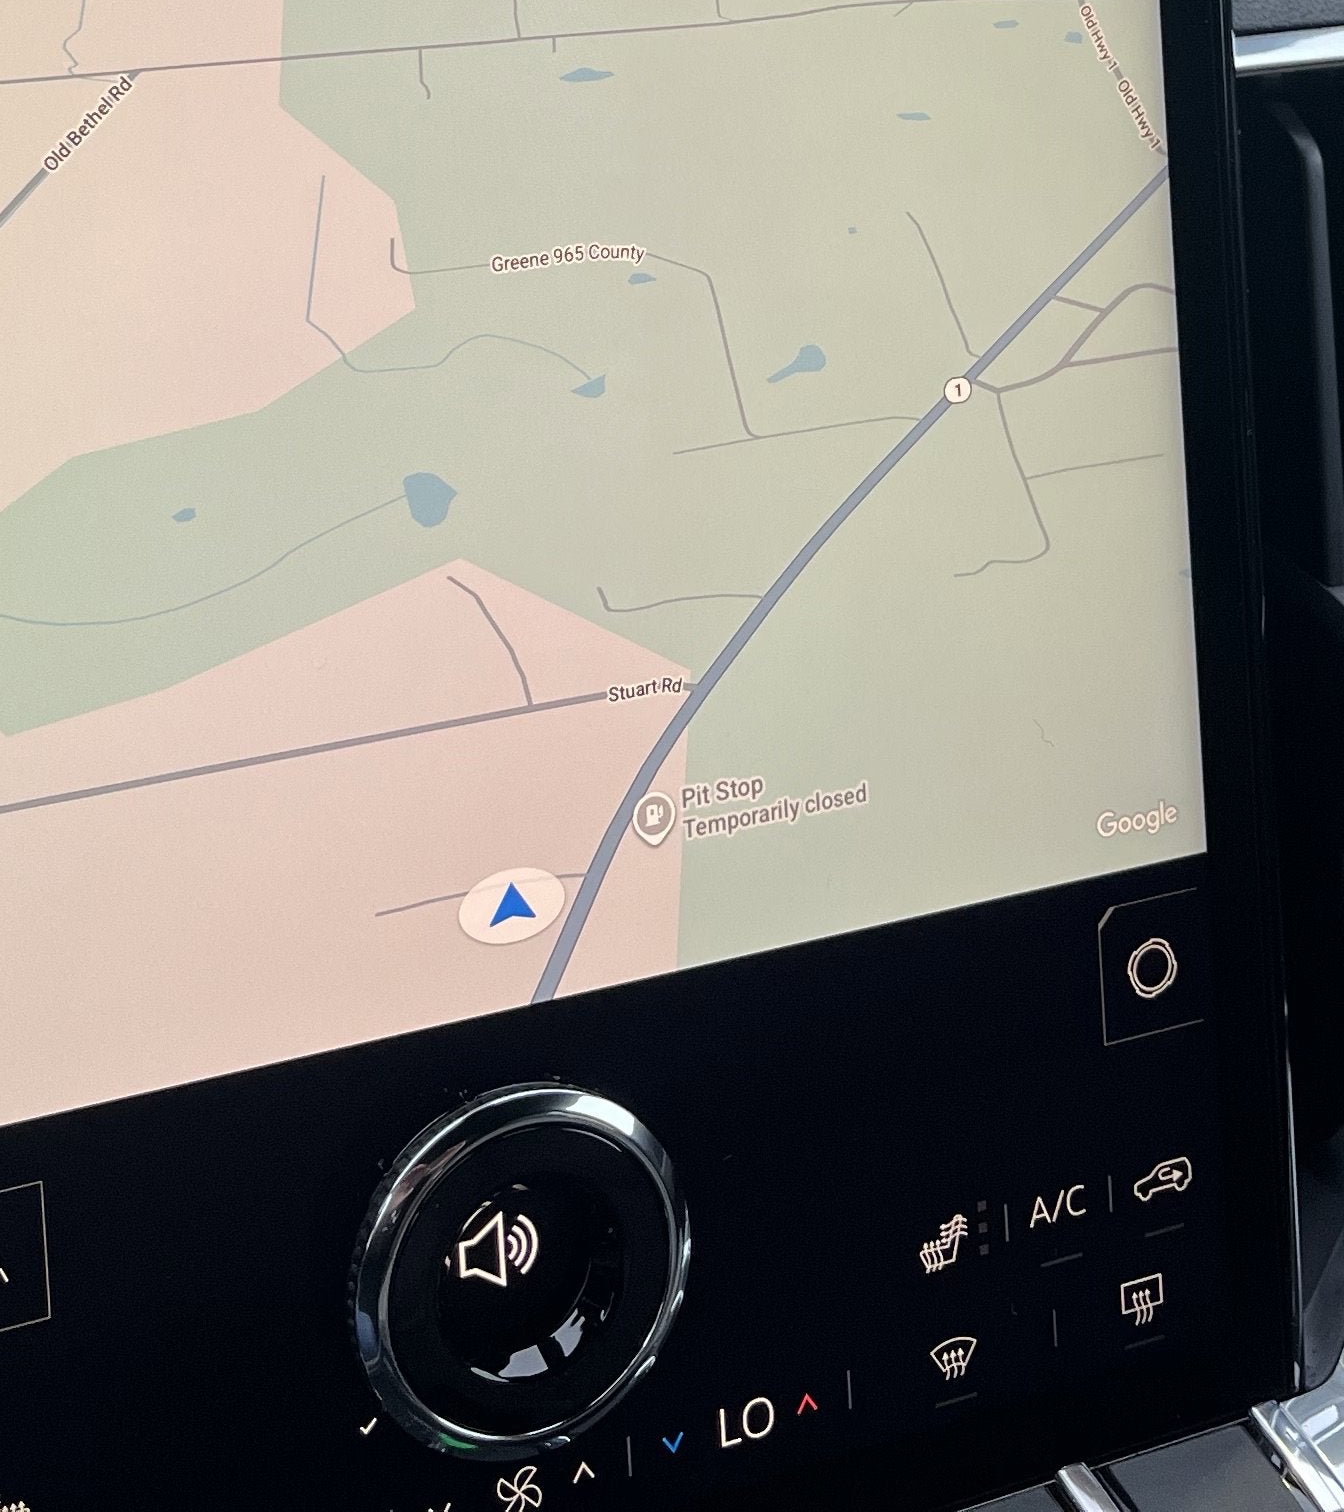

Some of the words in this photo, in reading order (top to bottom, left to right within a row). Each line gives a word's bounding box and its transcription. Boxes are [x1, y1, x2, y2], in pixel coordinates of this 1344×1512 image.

[1080, 5, 1098, 29] Old
[1091, 29, 1110, 61] Hwy
[1108, 60, 1118, 71] 1
[43, 142, 71, 171] Old
[66, 96, 114, 146] Bethel
[107, 75, 133, 102] Rd
[1118, 79, 1138, 106] Old
[1131, 105, 1154, 139] Hwy
[1150, 138, 1161, 150] 1
[491, 252, 549, 272] Greene
[553, 245, 585, 264] 965
[588, 243, 645, 265] County
[608, 679, 657, 702] Stuart
[661, 677, 683, 693] Rd
[682, 785, 710, 809] Pit
[716, 777, 764, 801] Stop
[682, 798, 800, 838] Temporarily
[805, 782, 868, 814] closed
[1096, 800, 1178, 837] Google
[1029, 1184, 1087, 1229] A/C
[719, 1396, 775, 1448] LO
